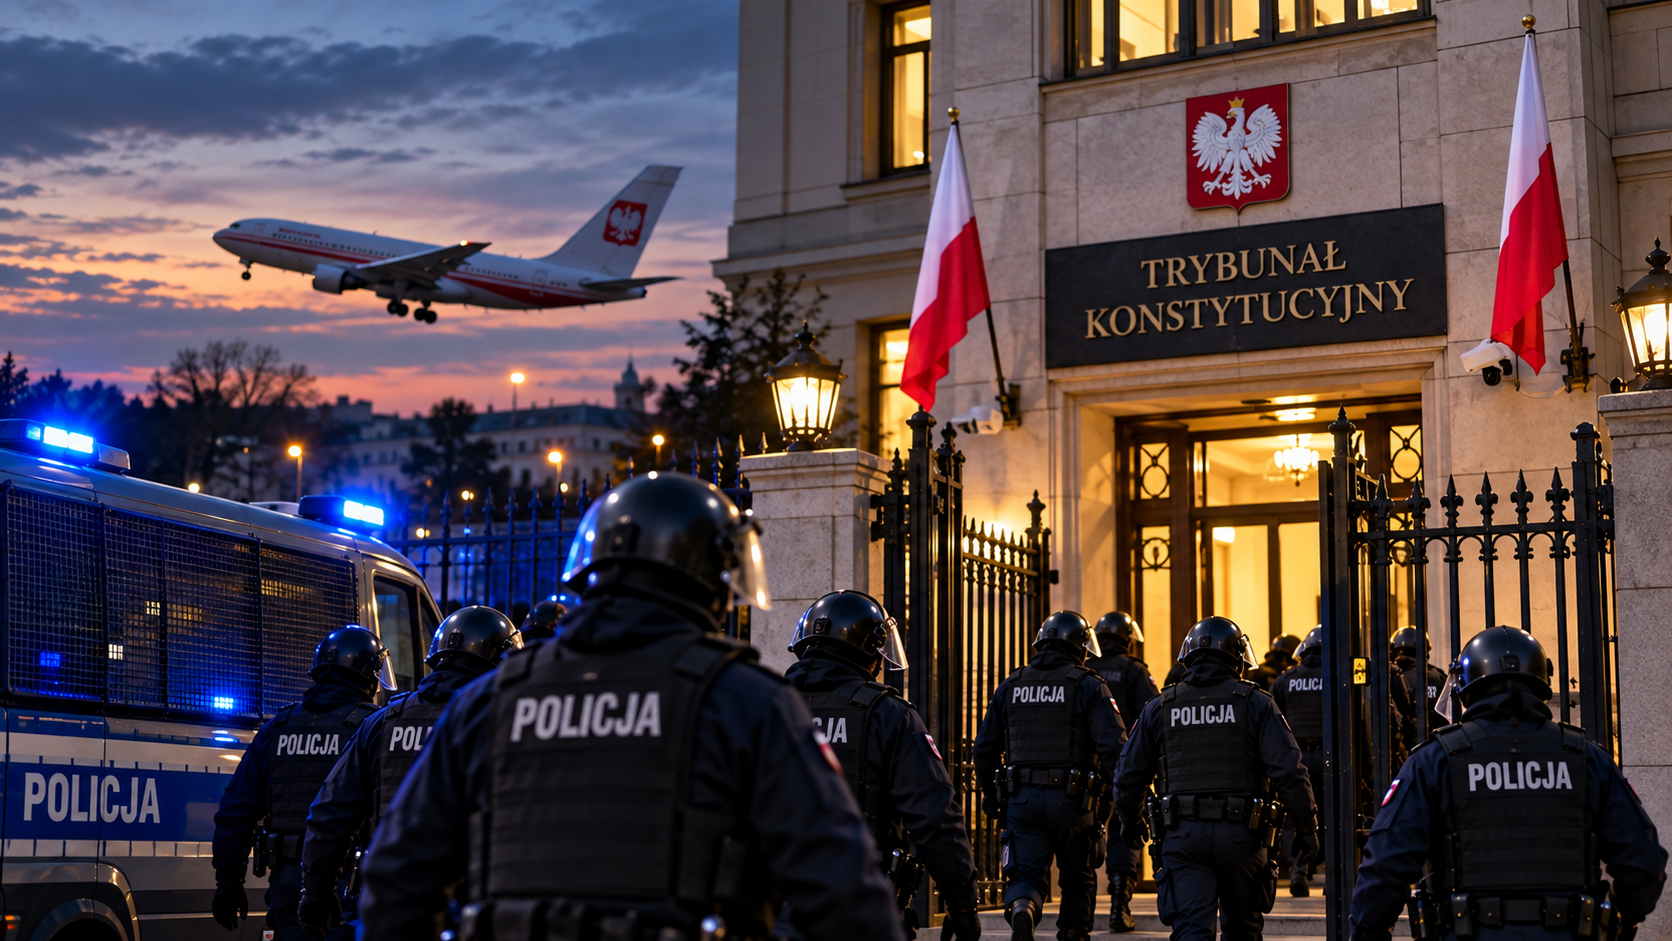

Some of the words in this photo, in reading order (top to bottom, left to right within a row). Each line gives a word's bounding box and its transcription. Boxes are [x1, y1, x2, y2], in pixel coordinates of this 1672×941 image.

[1140, 240, 1347, 289] TRYBUNAŁ
[1085, 278, 1415, 339] KONSTYTUCYJNY
[1012, 685, 1065, 704] POLICJA
[511, 692, 661, 742] POLICJA
[1170, 704, 1236, 727] POLICJA
[276, 733, 339, 756] POLICJA
[1467, 760, 1573, 791] POLICJA
[23, 772, 161, 823] POLICJA
